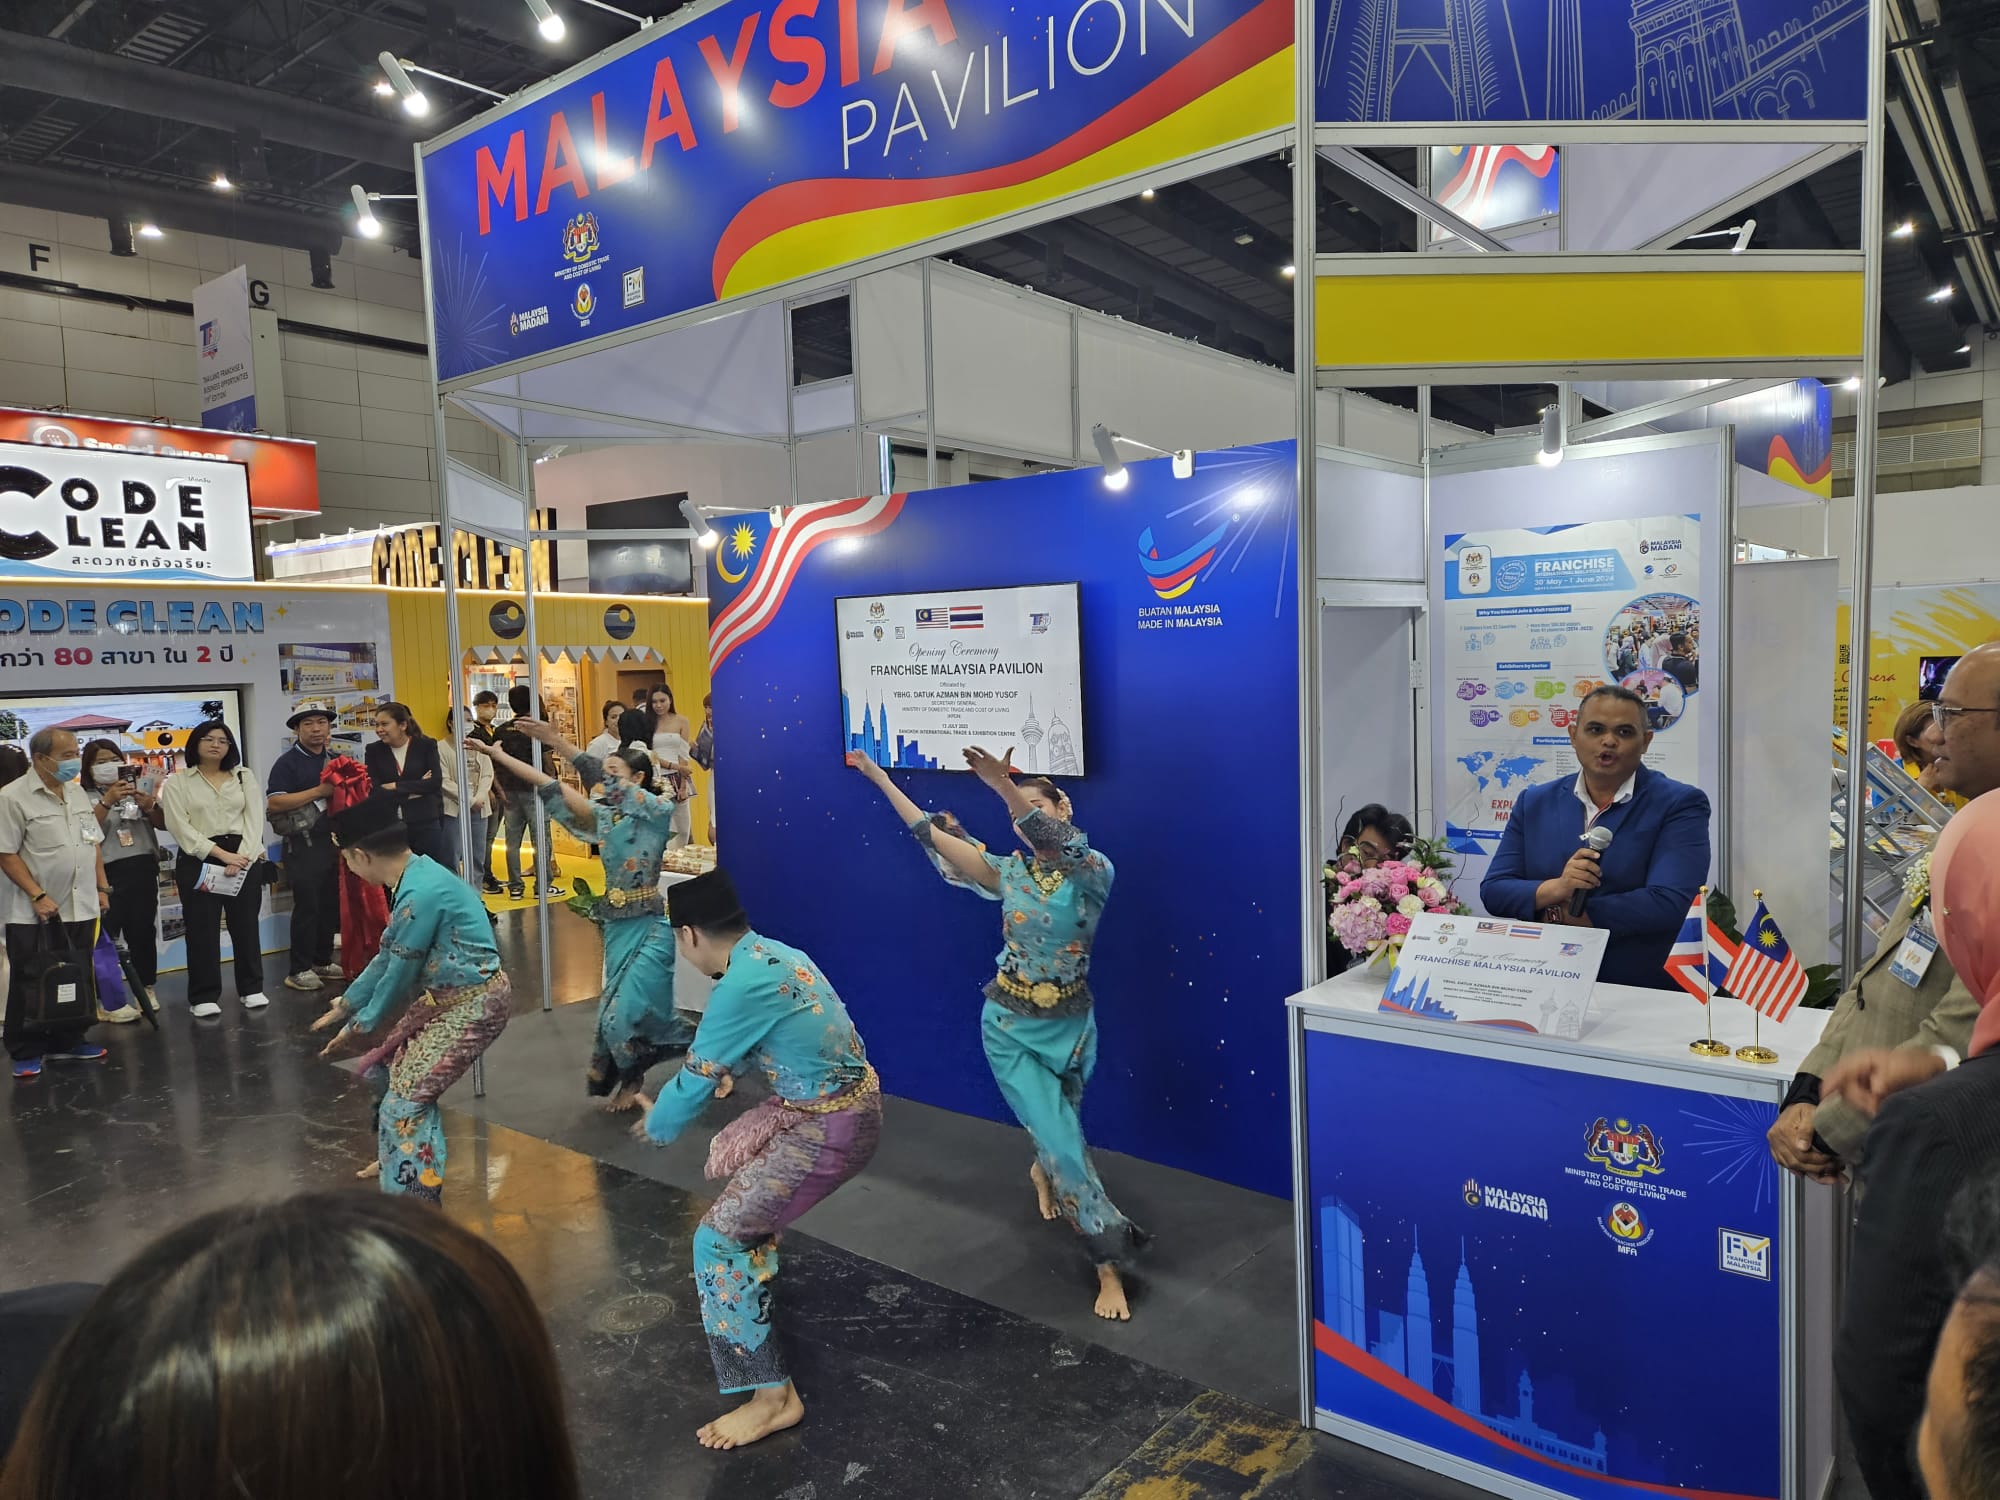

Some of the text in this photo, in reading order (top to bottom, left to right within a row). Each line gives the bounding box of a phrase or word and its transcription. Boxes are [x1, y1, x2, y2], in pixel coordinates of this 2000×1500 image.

[839, 0, 1196, 169] PAVILION
[475, 0, 958, 235] MALAYSIA
[29, 243, 50, 271] F
[250, 280, 270, 306] G
[519, 305, 548, 320] MALAYSIA
[519, 313, 549, 331] MADANI
[1650, 544, 1682, 552] MADANI
[1535, 557, 1615, 573] FRANCHISE
[106, 600, 265, 635] CLEAN
[1138, 603, 1221, 617] BUATAN MALAYSIA
[1138, 616, 1223, 630] MADE IN MALAYSIA
[54, 647, 93, 666] 80
[101, 649, 155, 665] สาขา
[163, 647, 188, 664] ใน
[197, 646, 211, 663] 2
[219, 643, 234, 662] ปี
[909, 639, 999, 662] Opening Ceremony
[870, 662, 1043, 676] FRANCHISE MALAYSIA PAVILION
[936, 690, 959, 699] AZMAN
[960, 690, 972, 699] BIN
[973, 691, 994, 699] MOHD
[995, 691, 1018, 699] YUSOF
[1449, 947, 1489, 960] Opening
[1414, 954, 1580, 980] FRANCHISE MALAYSIA PAVILION
[1565, 1167, 1601, 1180] MINISTRY
[1602, 1174, 1613, 1182] OF
[1615, 1177, 1657, 1192] DOMESTIC
[1658, 1185, 1687, 1198] TRADE
[1584, 1177, 1667, 1200] AND COST OF LIVING
[1484, 1185, 1548, 1207] MALAYSIA
[1484, 1195, 1549, 1222] MADANI
[1612, 1235, 1636, 1248] FRANCHISE
[1617, 1245, 1638, 1257] MFA
[1726, 1254, 1762, 1266] FRANCHISE
[1726, 1260, 1762, 1273] MALAYSIA
